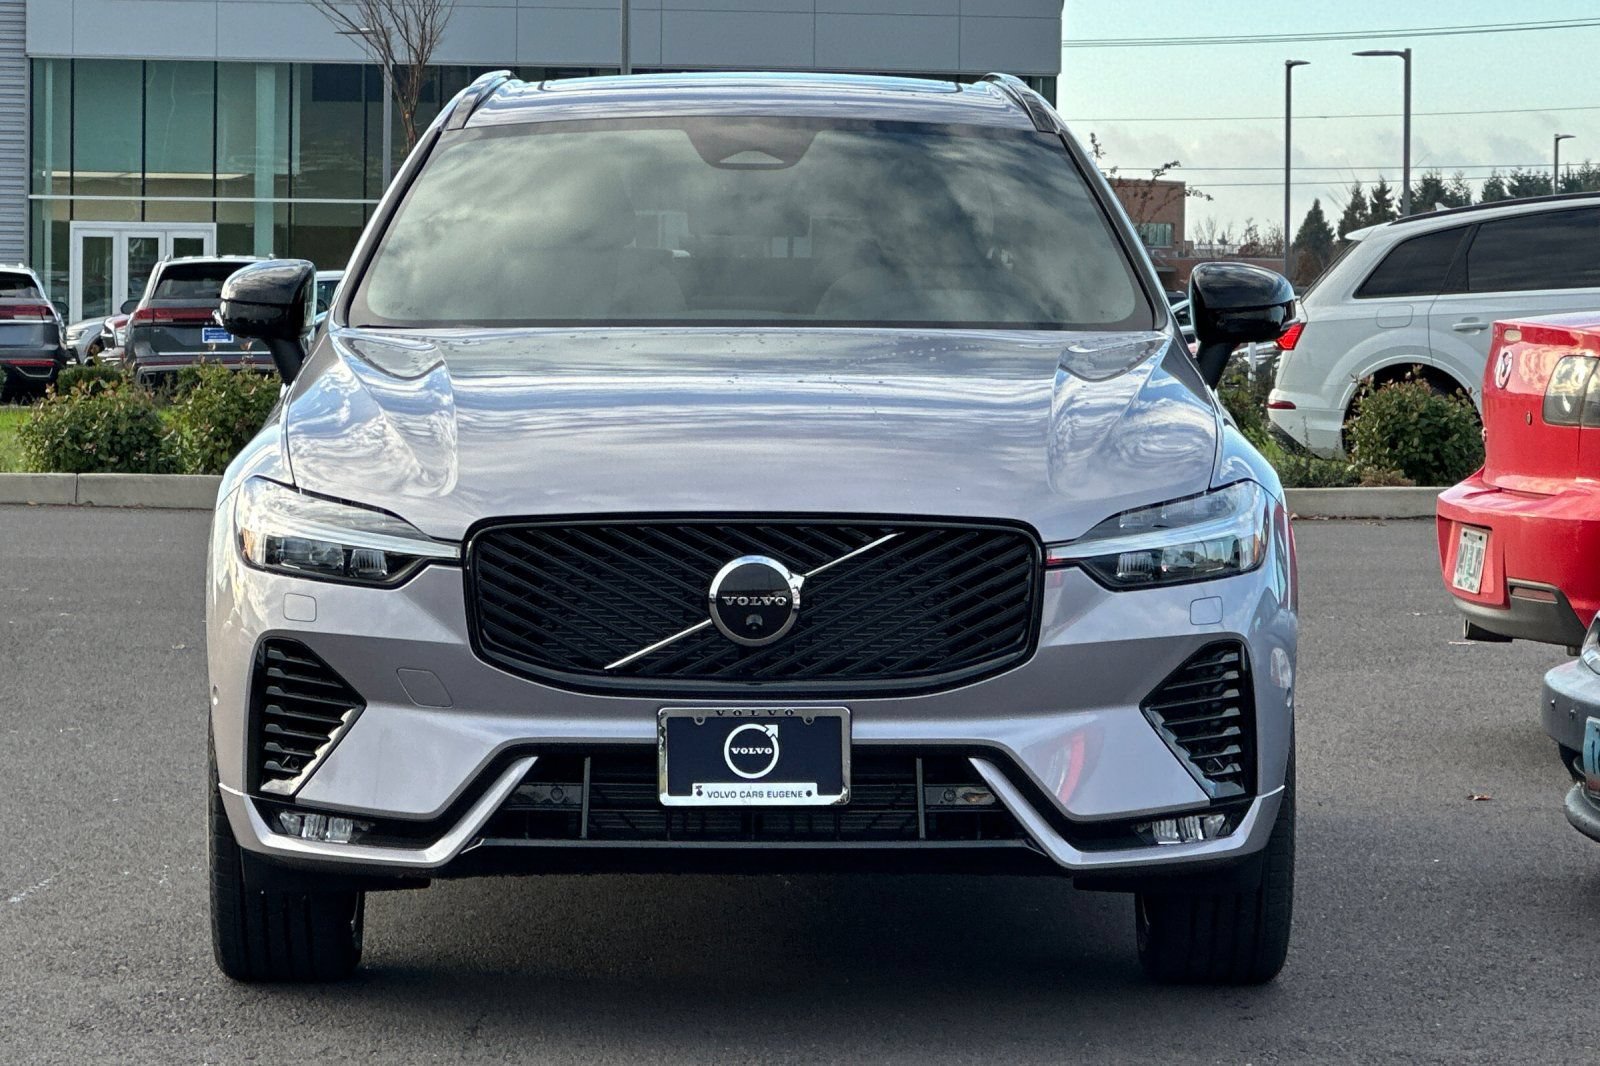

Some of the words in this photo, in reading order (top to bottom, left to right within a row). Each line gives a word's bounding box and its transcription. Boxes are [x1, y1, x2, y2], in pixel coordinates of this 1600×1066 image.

[721, 596, 787, 606] VOLVO
[716, 709, 794, 717] VOLVO
[731, 747, 773, 755] VOLVO
[706, 790, 737, 798] VOLVO
[739, 790, 764, 798] CARS
[767, 790, 803, 798] EUGENE
